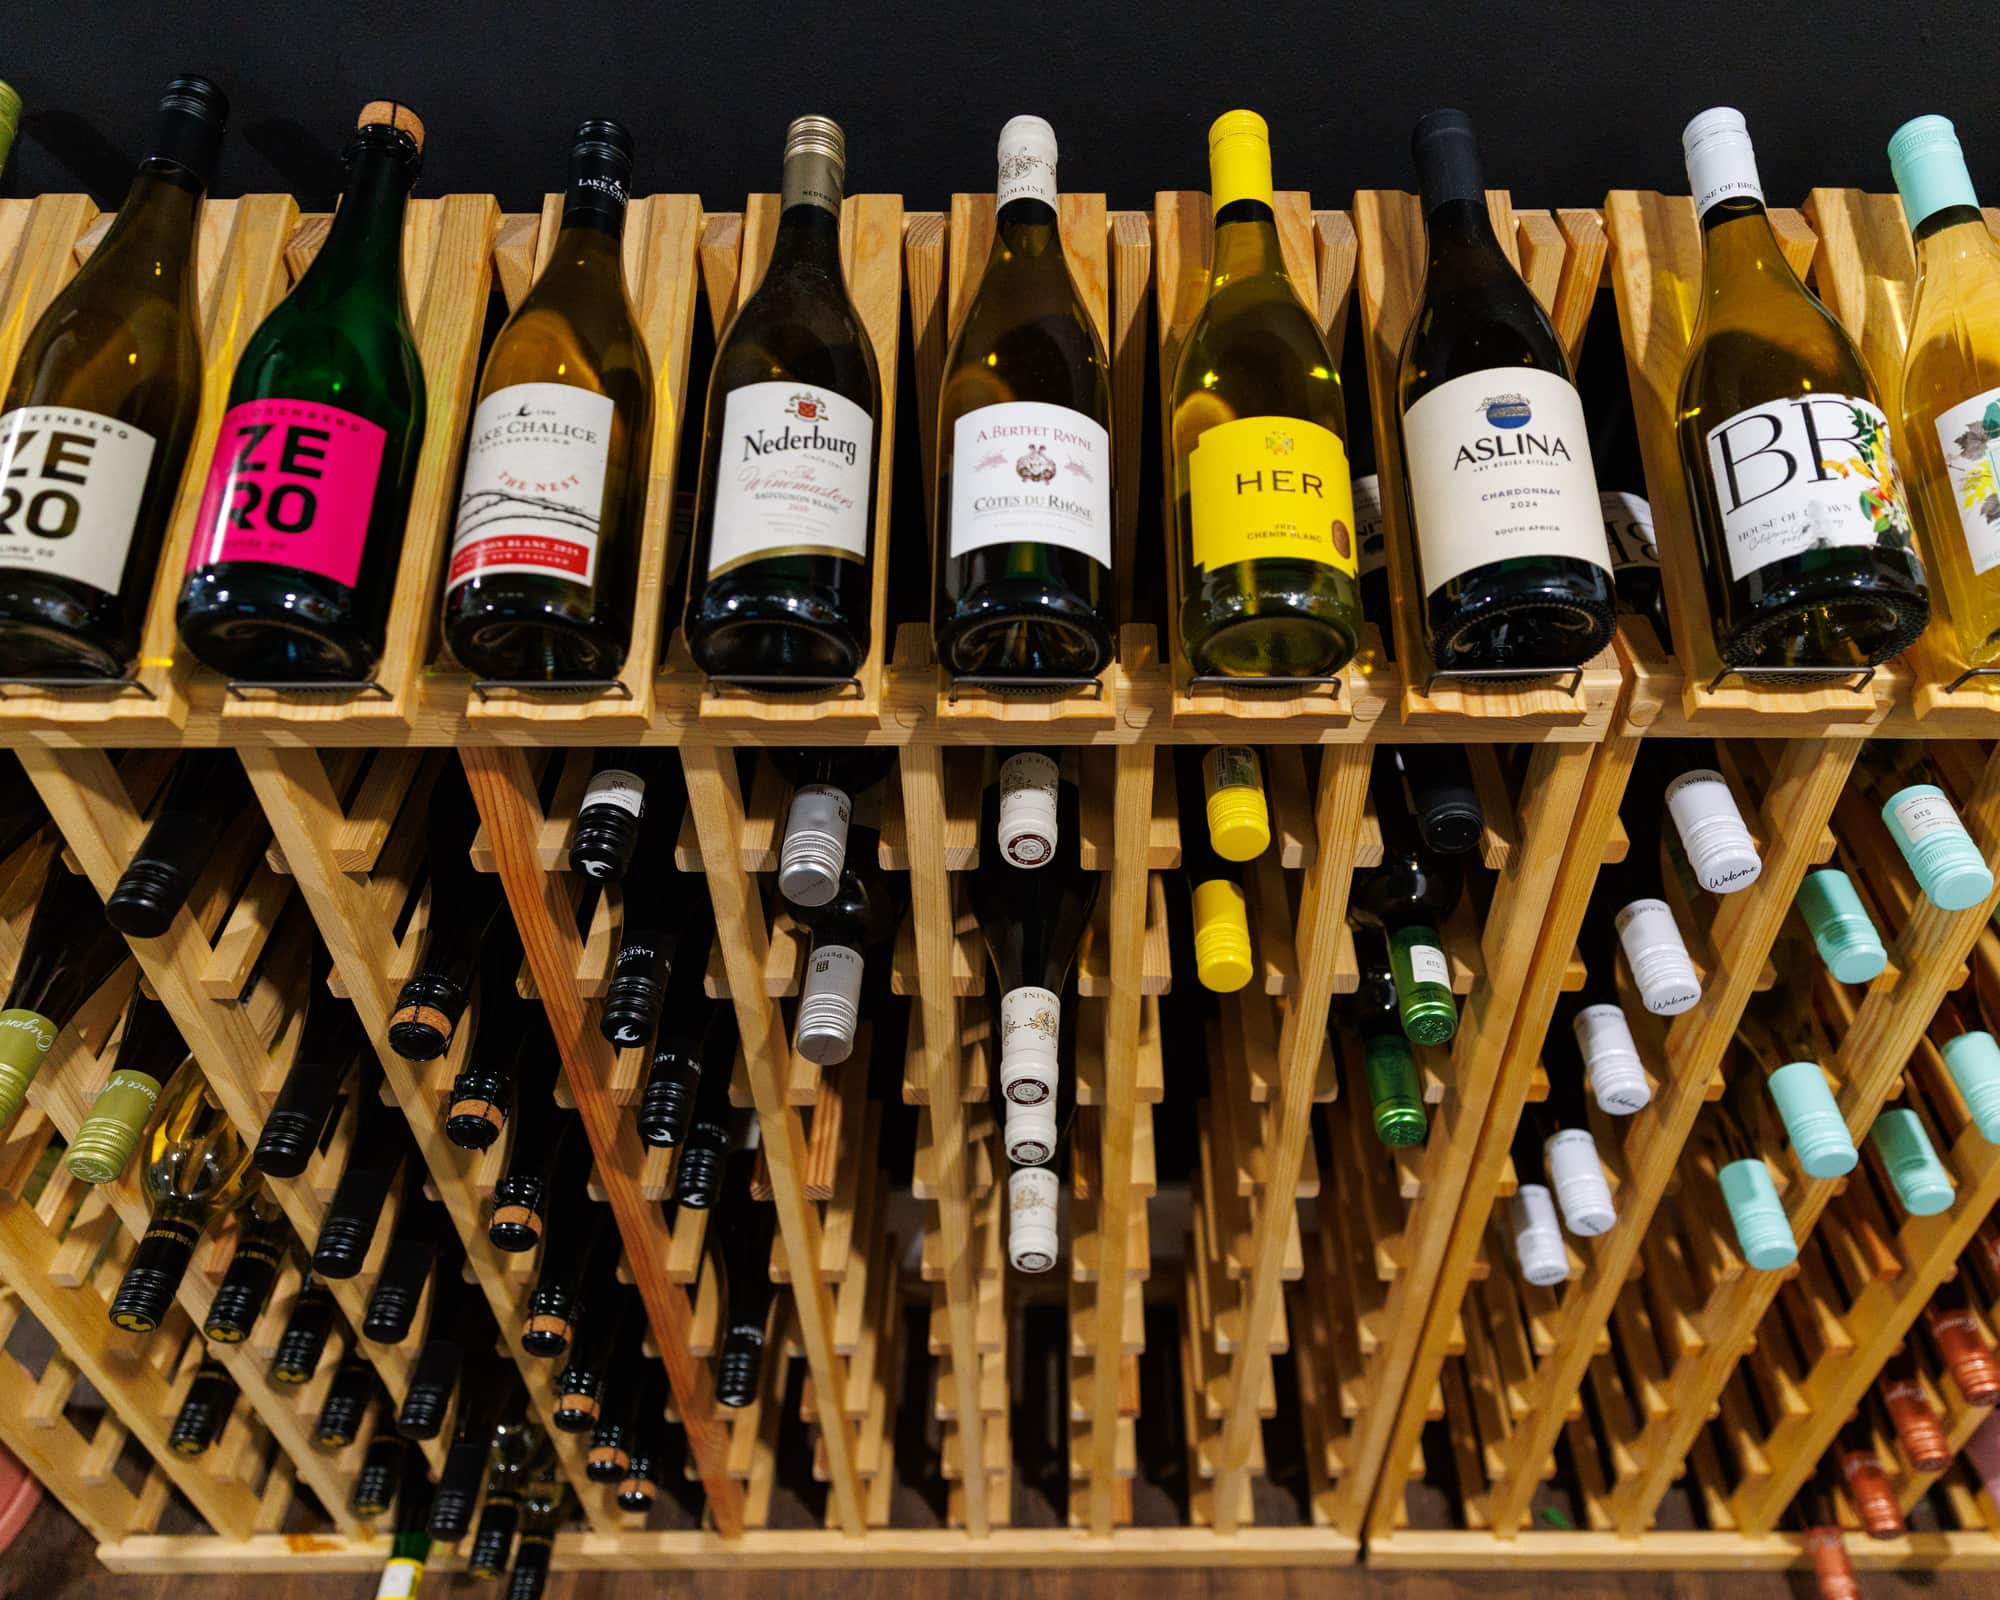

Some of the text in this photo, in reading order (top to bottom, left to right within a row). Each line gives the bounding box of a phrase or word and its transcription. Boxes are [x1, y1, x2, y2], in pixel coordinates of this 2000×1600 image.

[578, 178, 608, 190] LAKE
[506, 420, 598, 446] CHALICE
[229, 423, 331, 480] ZE
[742, 425, 857, 466] Nederburg
[1454, 433, 1572, 472] ASLINA
[535, 475, 580, 492] NEST
[1236, 470, 1324, 499] HER
[1025, 495, 1044, 506] DU
[1481, 487, 1562, 502] CHARDONNAY
[213, 481, 317, 534] RO
[1510, 501, 1539, 511] 2024
[1495, 524, 1561, 537] SOUTH AFRICA
[1709, 865, 1758, 890] Welcome
[627, 946, 655, 959] LAKE
